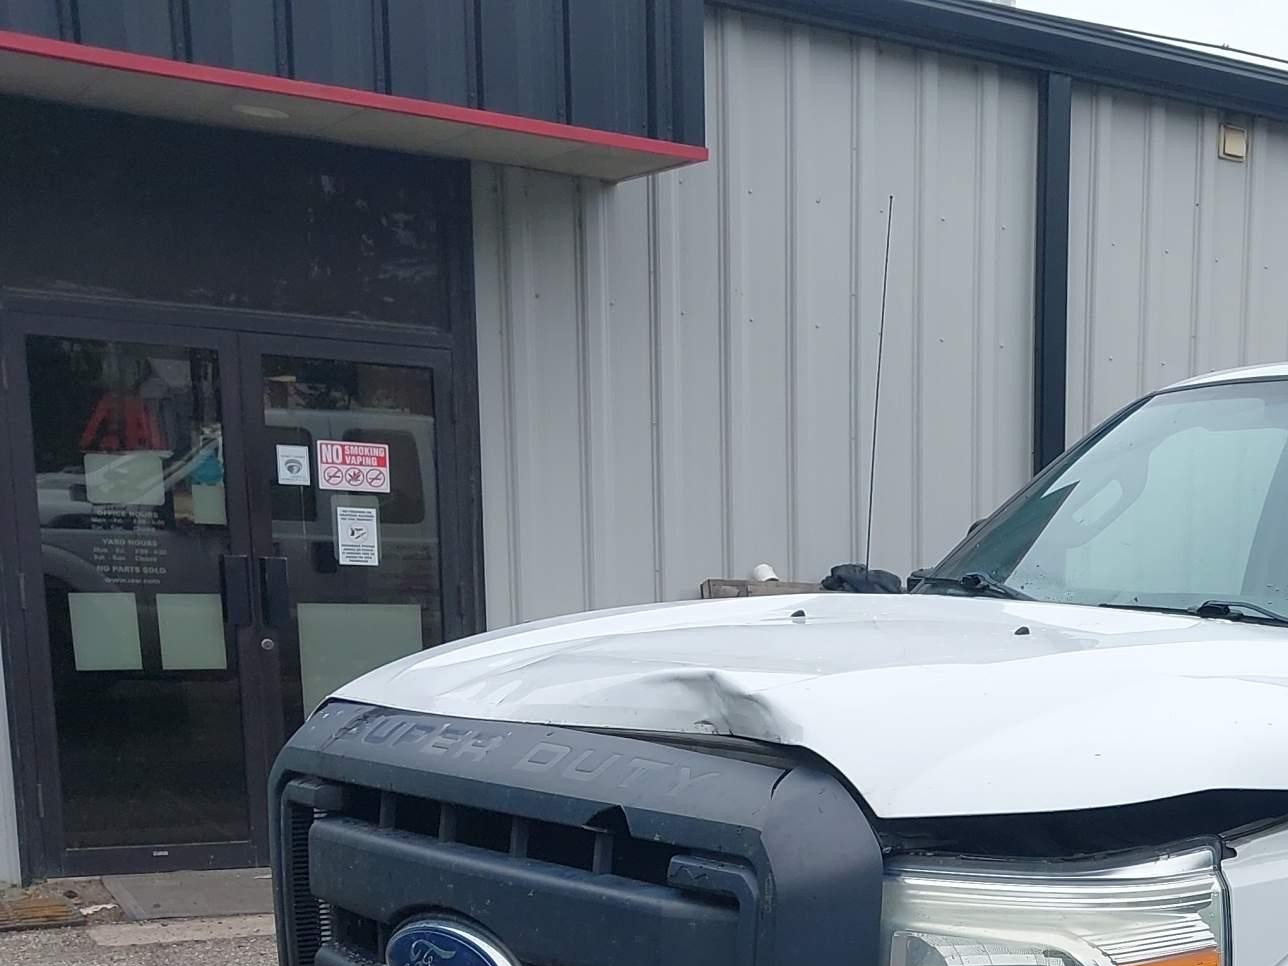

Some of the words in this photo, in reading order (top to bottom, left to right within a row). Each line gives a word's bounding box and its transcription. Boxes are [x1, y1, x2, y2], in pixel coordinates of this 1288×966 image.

[321, 443, 342, 464] NO
[344, 446, 385, 457] SMOKING
[344, 455, 378, 466] VAPING
[129, 511, 159, 519] HOURS
[127, 539, 158, 547] HOURS
[112, 565, 140, 574] PARTS
[142, 566, 167, 575] SOLD
[512, 741, 720, 797] DUTY
